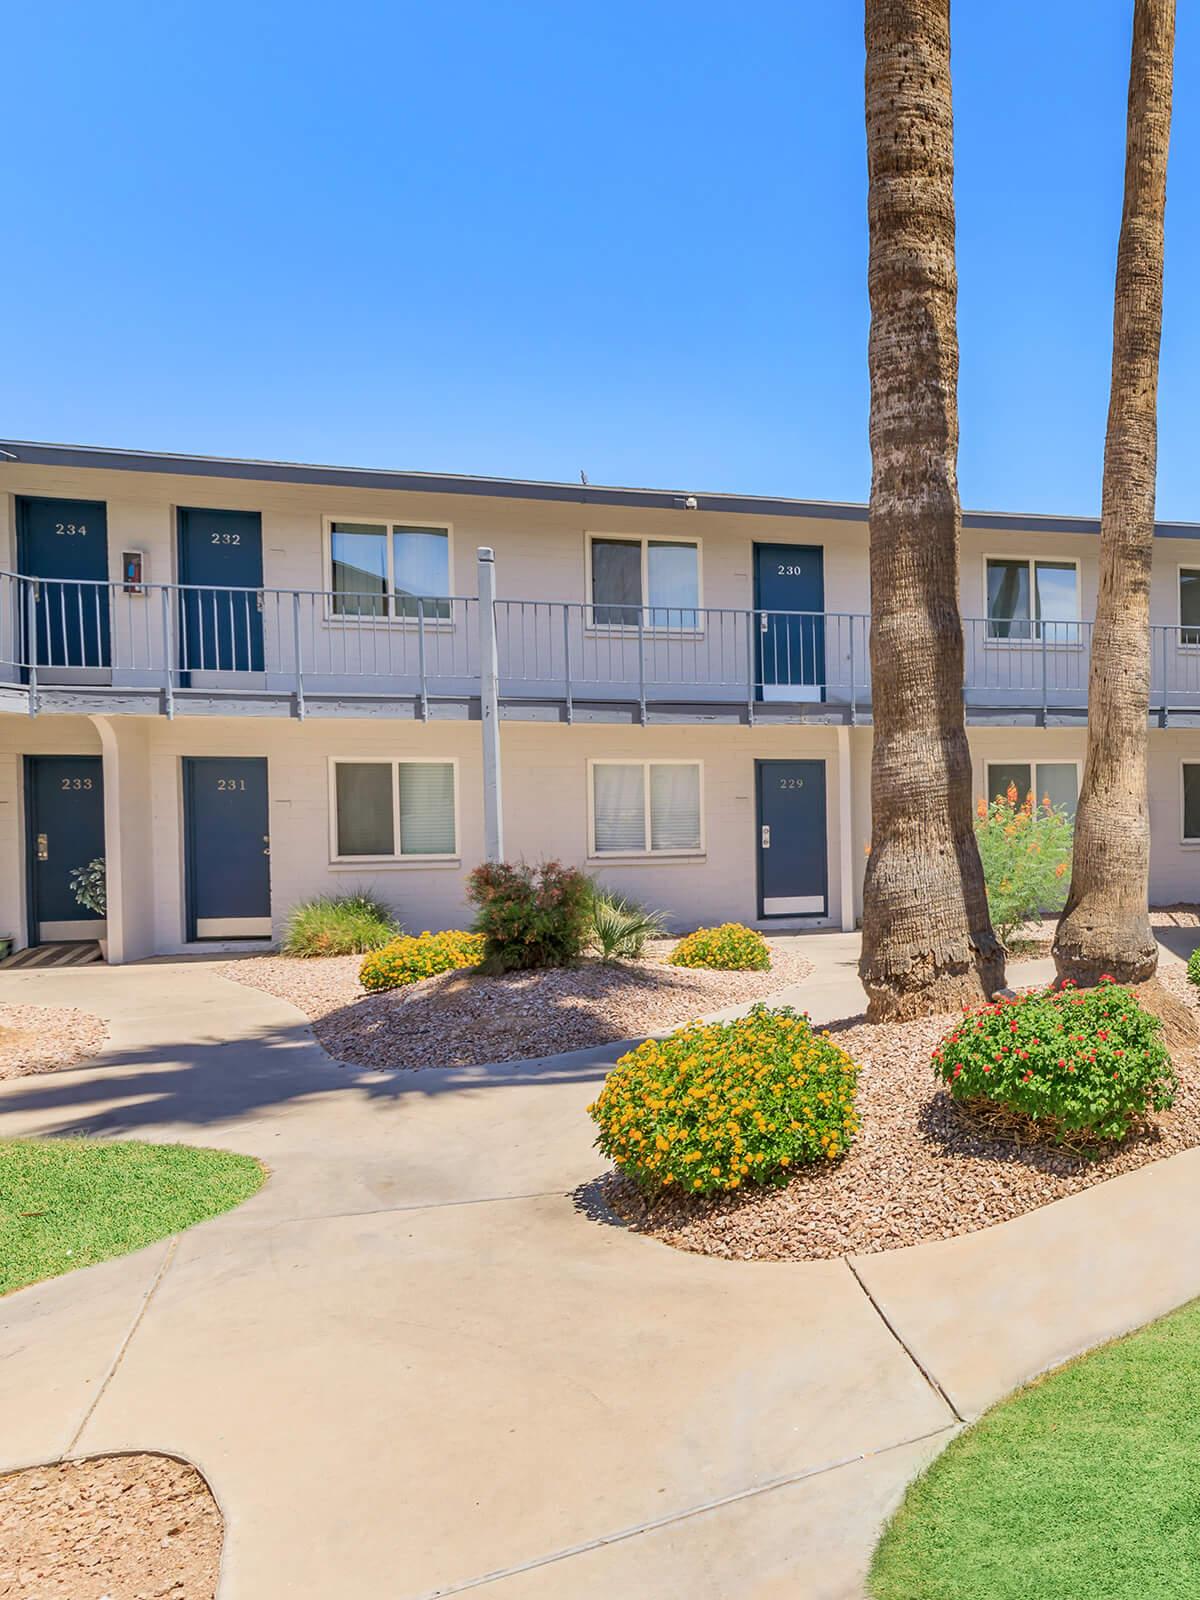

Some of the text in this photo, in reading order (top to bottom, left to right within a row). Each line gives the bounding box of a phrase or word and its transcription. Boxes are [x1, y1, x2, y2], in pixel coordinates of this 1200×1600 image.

[55, 523, 86, 536] 234
[211, 533, 240, 545] 232
[777, 565, 801, 575] 230
[61, 778, 92, 790] 233
[217, 779, 245, 790] 231
[780, 779, 803, 789] 229
